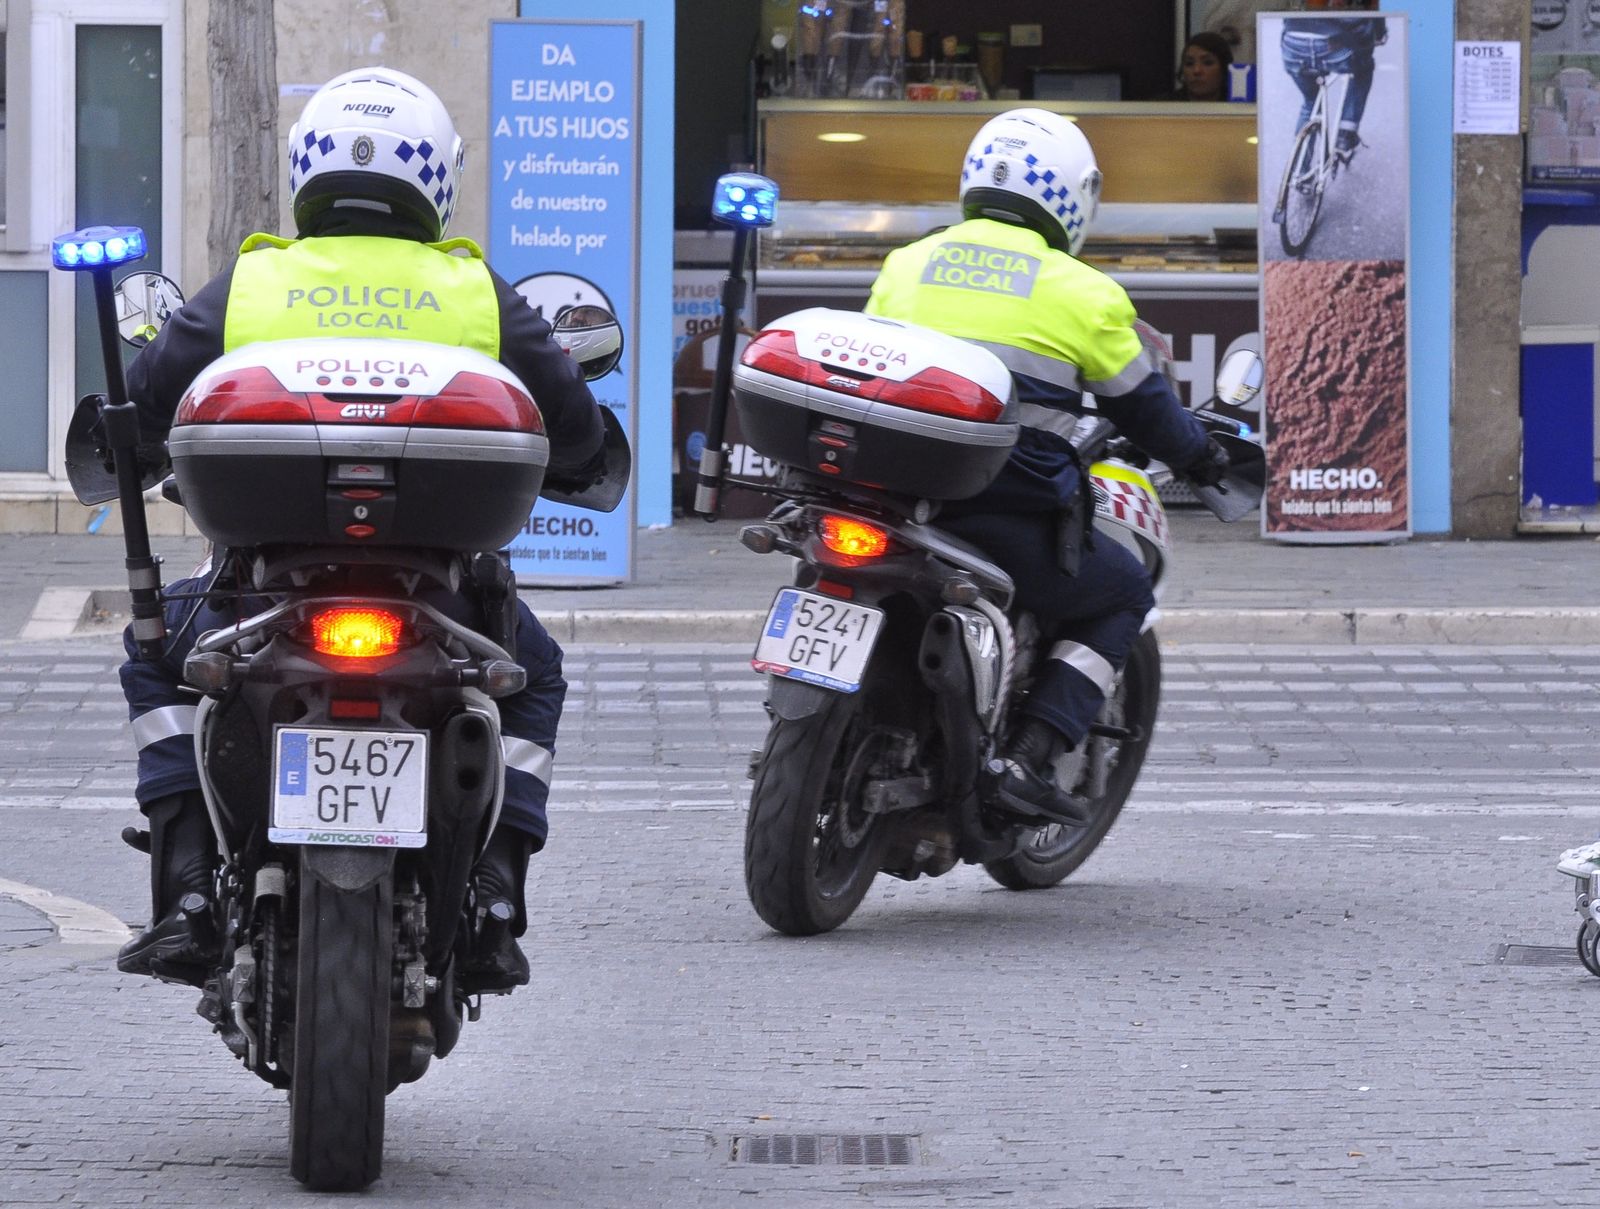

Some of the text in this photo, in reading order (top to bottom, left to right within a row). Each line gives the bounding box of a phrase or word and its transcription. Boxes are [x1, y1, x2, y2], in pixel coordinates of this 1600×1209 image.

[542, 44, 576, 65] DA
[1463, 46, 1504, 57] BOTES
[511, 80, 615, 103] EJEMPLO
[343, 103, 396, 118] NOLAN
[494, 116, 629, 139] A TUS HIJOS
[503, 153, 619, 181] y disfrutarán
[511, 189, 607, 212] de nuestro
[511, 225, 607, 255] helado por
[931, 247, 1030, 275] POLICIA
[933, 266, 1014, 292] LOCAL
[287, 286, 441, 312] POLICIA
[317, 312, 408, 330] LOCAL
[815, 332, 908, 366] POLICIA
[296, 358, 429, 377] POLICIA
[340, 403, 386, 418] GIVI
[1290, 467, 1383, 490] HECHO.
[773, 619, 785, 630] E
[797, 598, 869, 641] 5241
[789, 635, 848, 671] GFV
[314, 737, 415, 777] 5467
[287, 771, 299, 785] E
[318, 785, 391, 824] GFV
